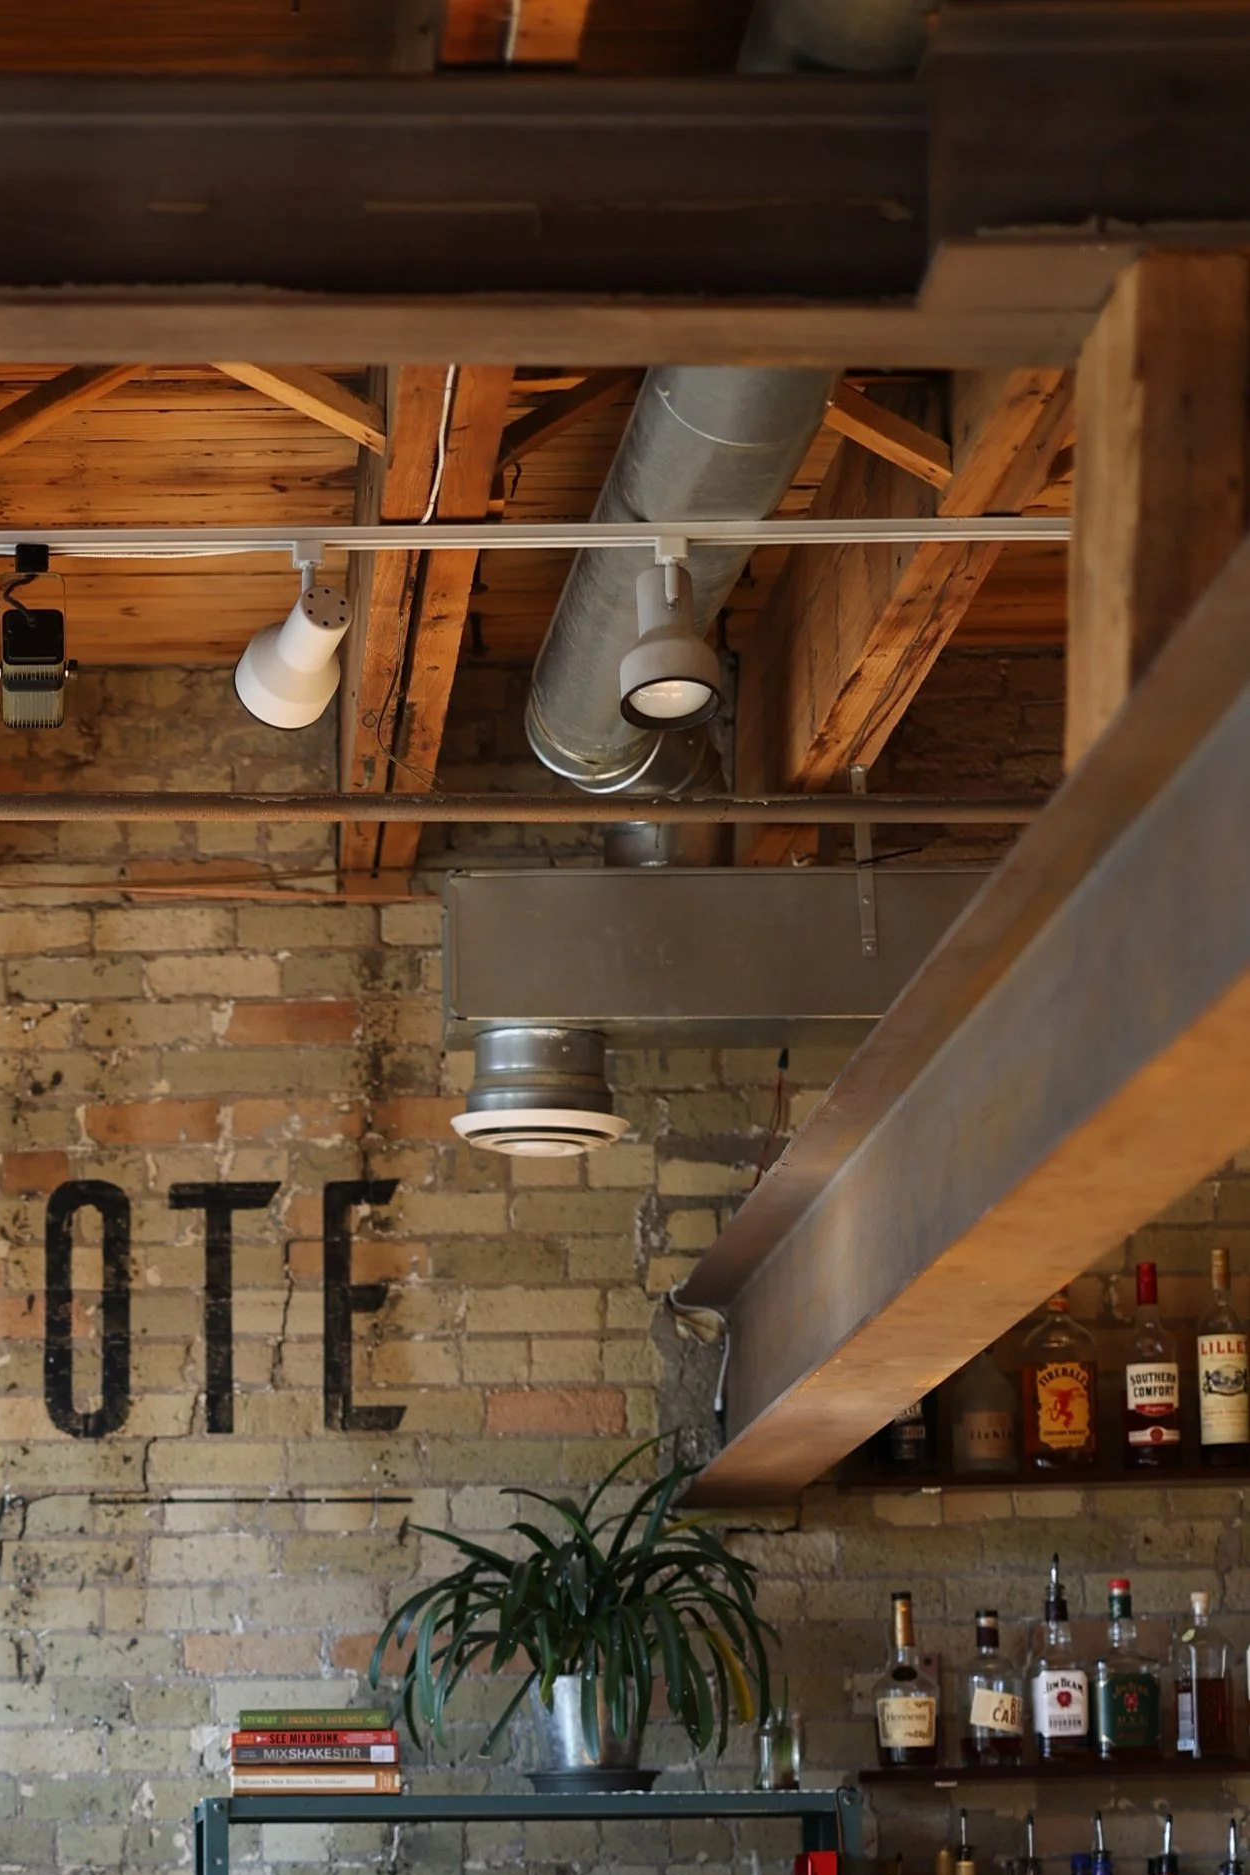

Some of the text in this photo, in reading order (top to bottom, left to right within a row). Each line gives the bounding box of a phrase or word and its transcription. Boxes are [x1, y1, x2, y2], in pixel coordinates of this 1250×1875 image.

[1039, 1366, 1089, 1390] FIREBALL
[1130, 1371, 1176, 1386] SOUTHERN
[1133, 1385, 1174, 1397] COMFORT
[1046, 1677, 1083, 1693] JIM BEAM
[269, 1733, 286, 1743] SEE
[290, 1733, 306, 1743] MIX
[310, 1733, 339, 1743] DRINK
[263, 1747, 361, 1760] MIXSHAKESTIR
